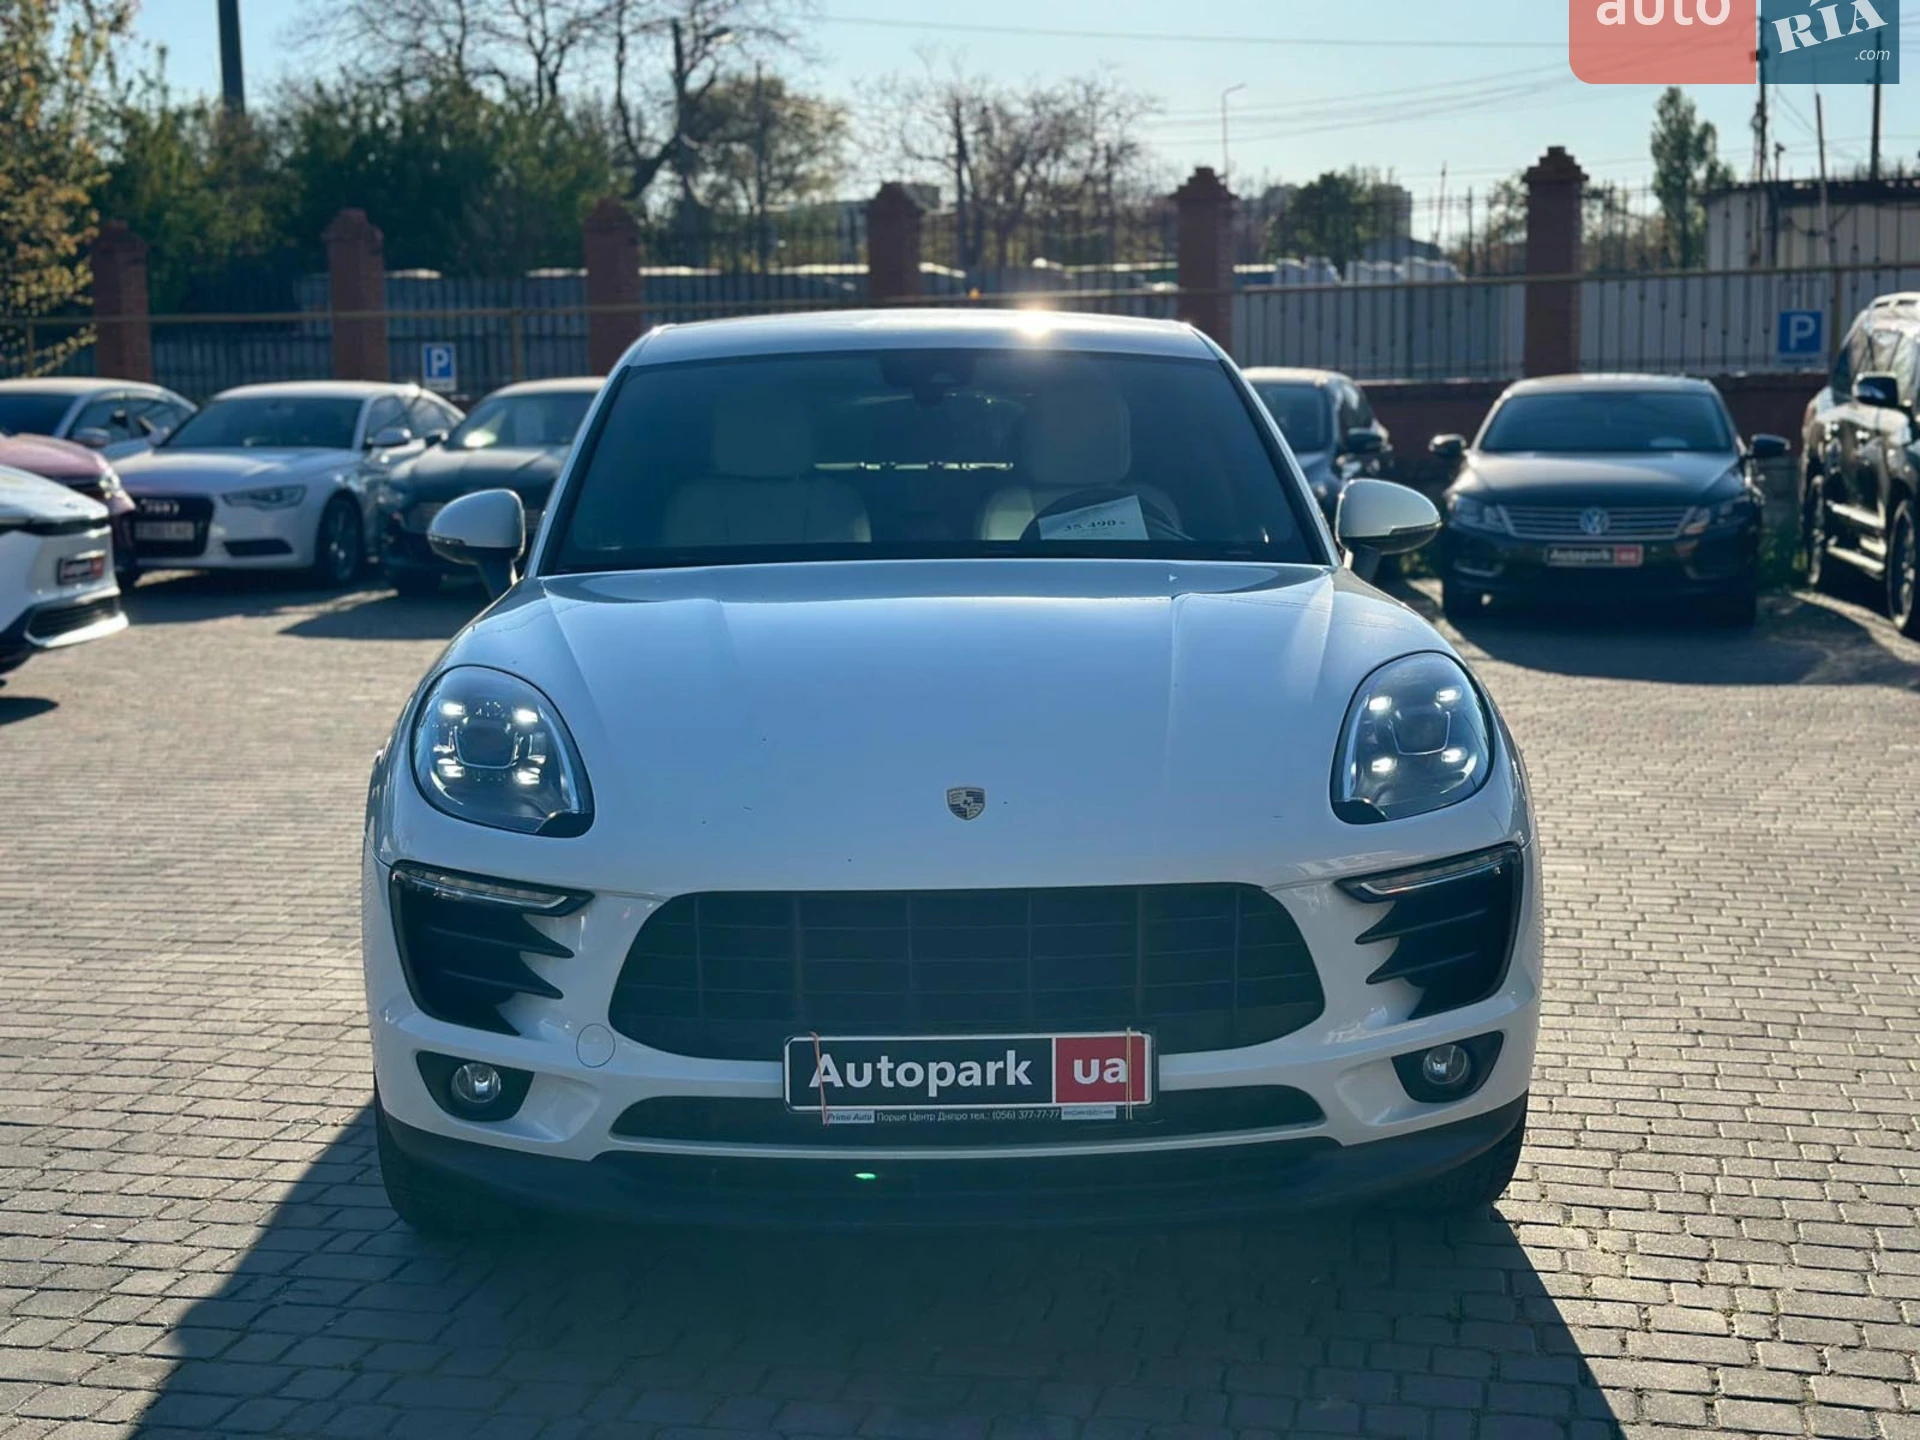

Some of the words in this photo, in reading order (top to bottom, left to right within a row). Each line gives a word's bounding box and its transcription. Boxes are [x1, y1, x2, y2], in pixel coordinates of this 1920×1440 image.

[1789, 314, 1816, 350] P
[431, 347, 450, 376] P
[809, 1050, 1032, 1097] Autopark
[1073, 1057, 1128, 1084] ua
[909, 1111, 936, 1122] Центр
[992, 1109, 1016, 1121] (056)
[1018, 1108, 1060, 1120] 377-77-77
